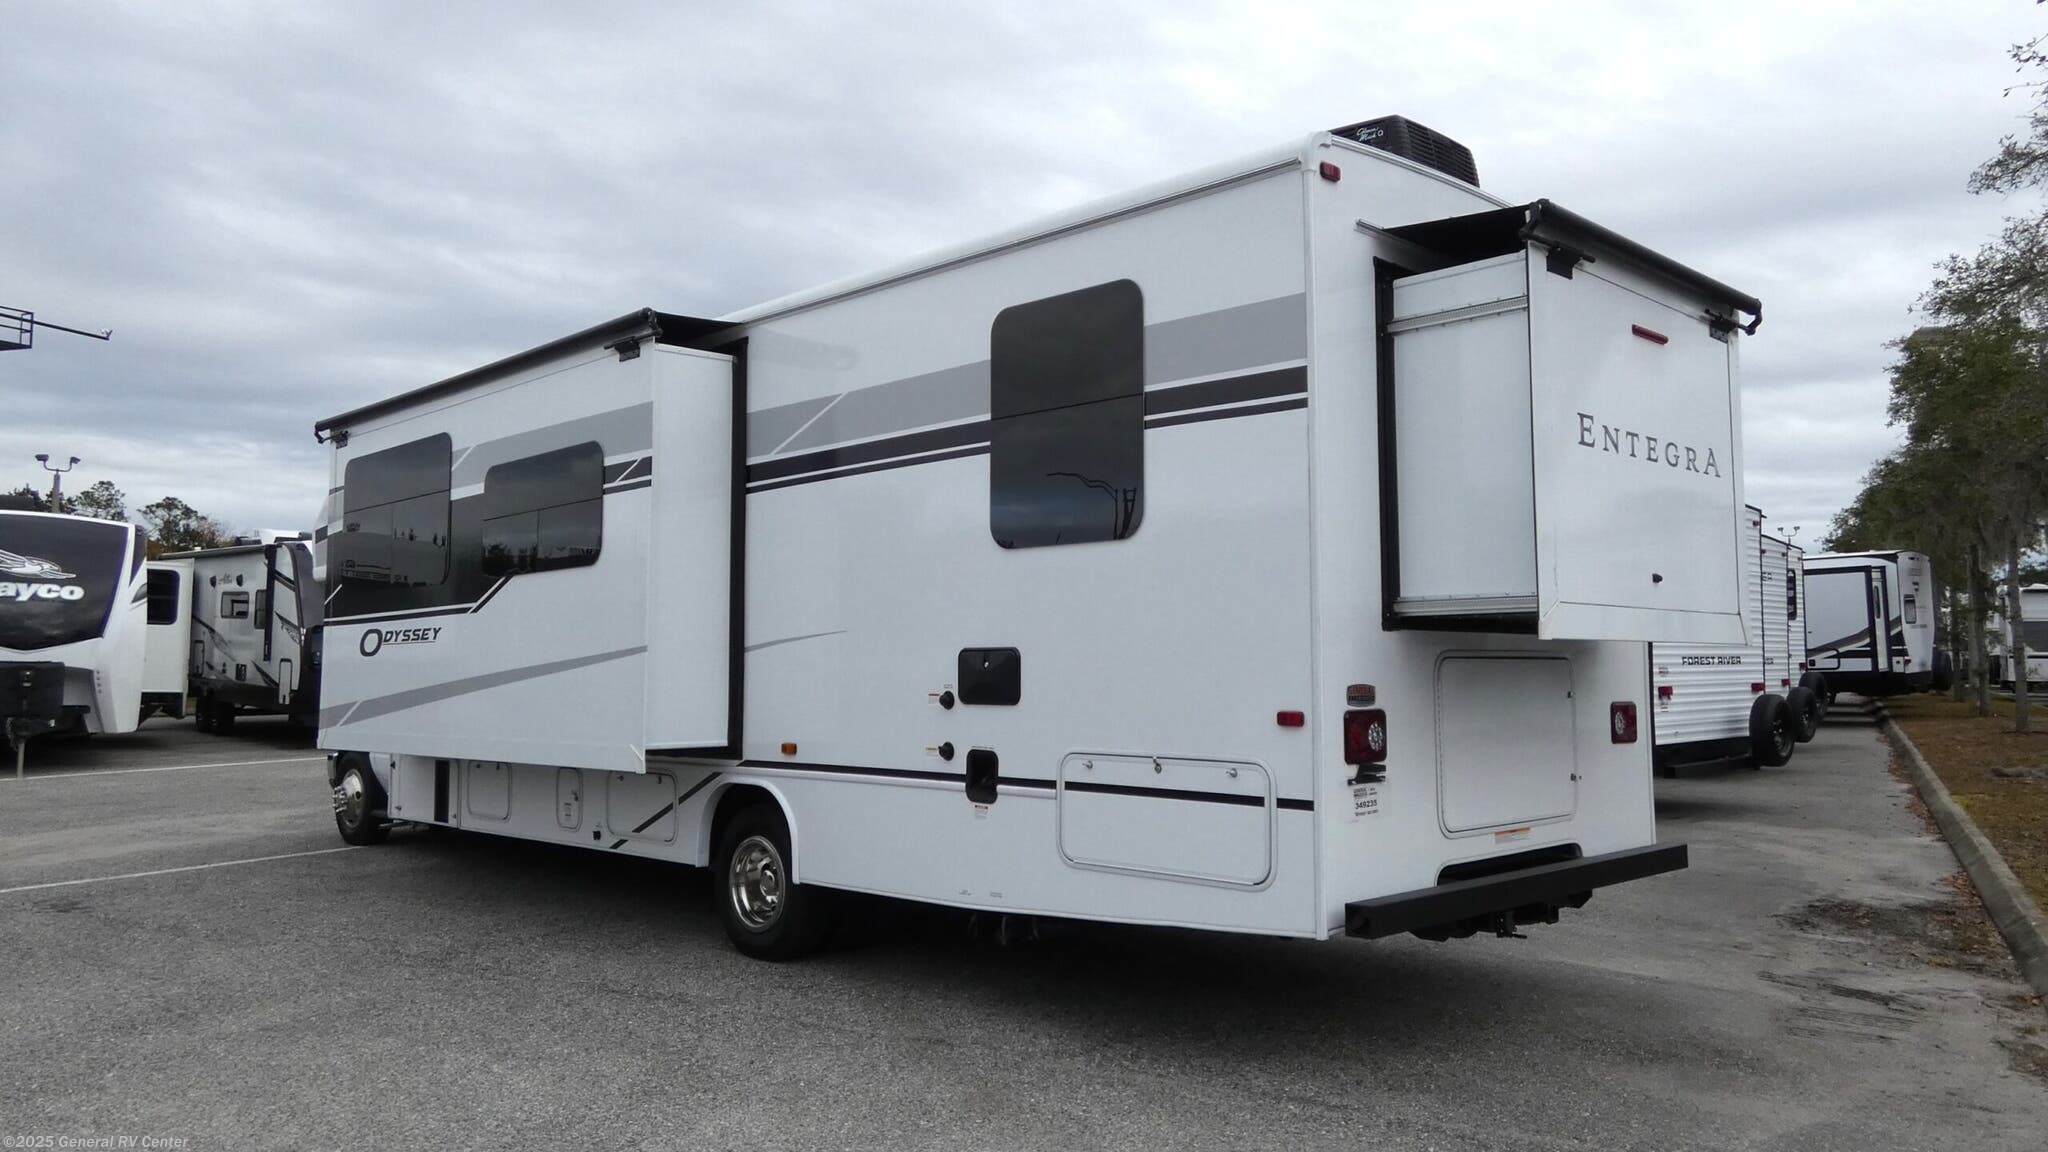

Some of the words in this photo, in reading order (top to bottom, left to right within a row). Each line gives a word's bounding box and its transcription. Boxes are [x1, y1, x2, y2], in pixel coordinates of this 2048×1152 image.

[1577, 412, 1721, 478] ENTEGRA
[0, 582, 85, 602] ayco
[360, 627, 442, 657] ODYSSEY
[1682, 656, 1715, 666] FOREST
[1717, 656, 1742, 665] RIVER
